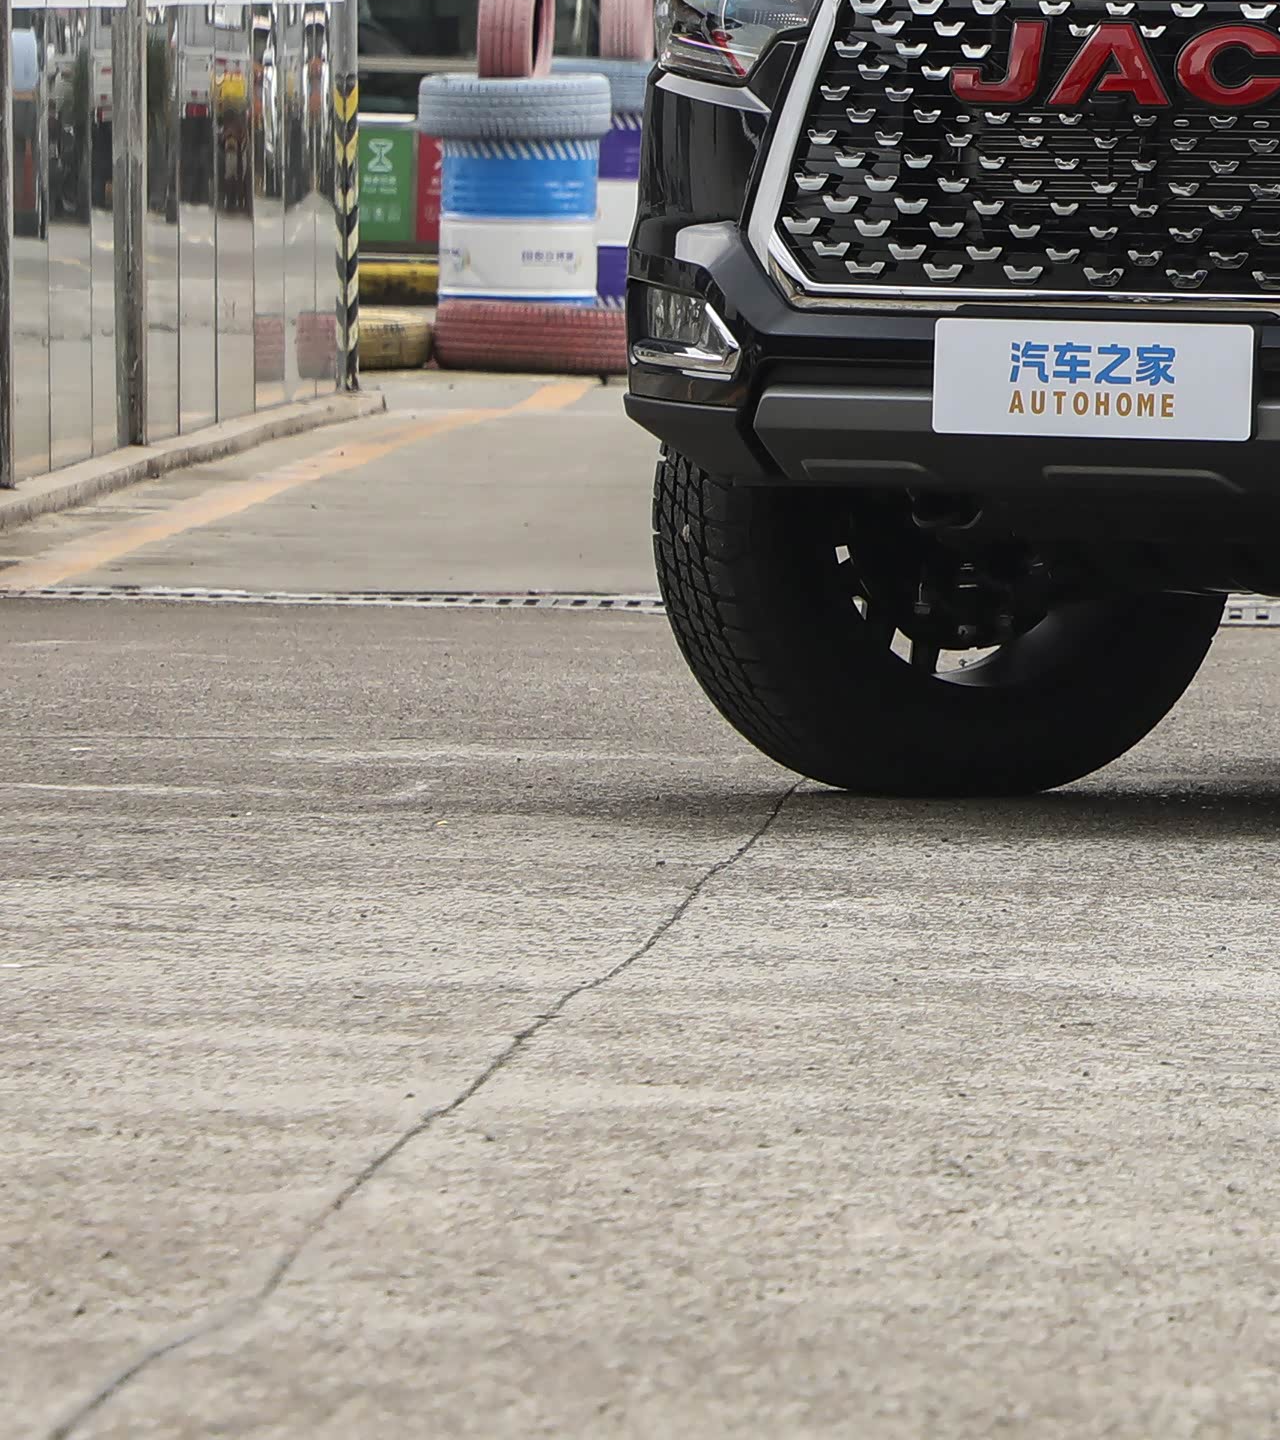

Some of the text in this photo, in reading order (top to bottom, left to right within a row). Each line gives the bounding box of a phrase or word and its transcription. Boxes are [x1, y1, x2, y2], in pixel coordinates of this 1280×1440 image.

[1009, 341, 1176, 386] 汽车之家
[1008, 390, 1175, 417] AUTOHOME
